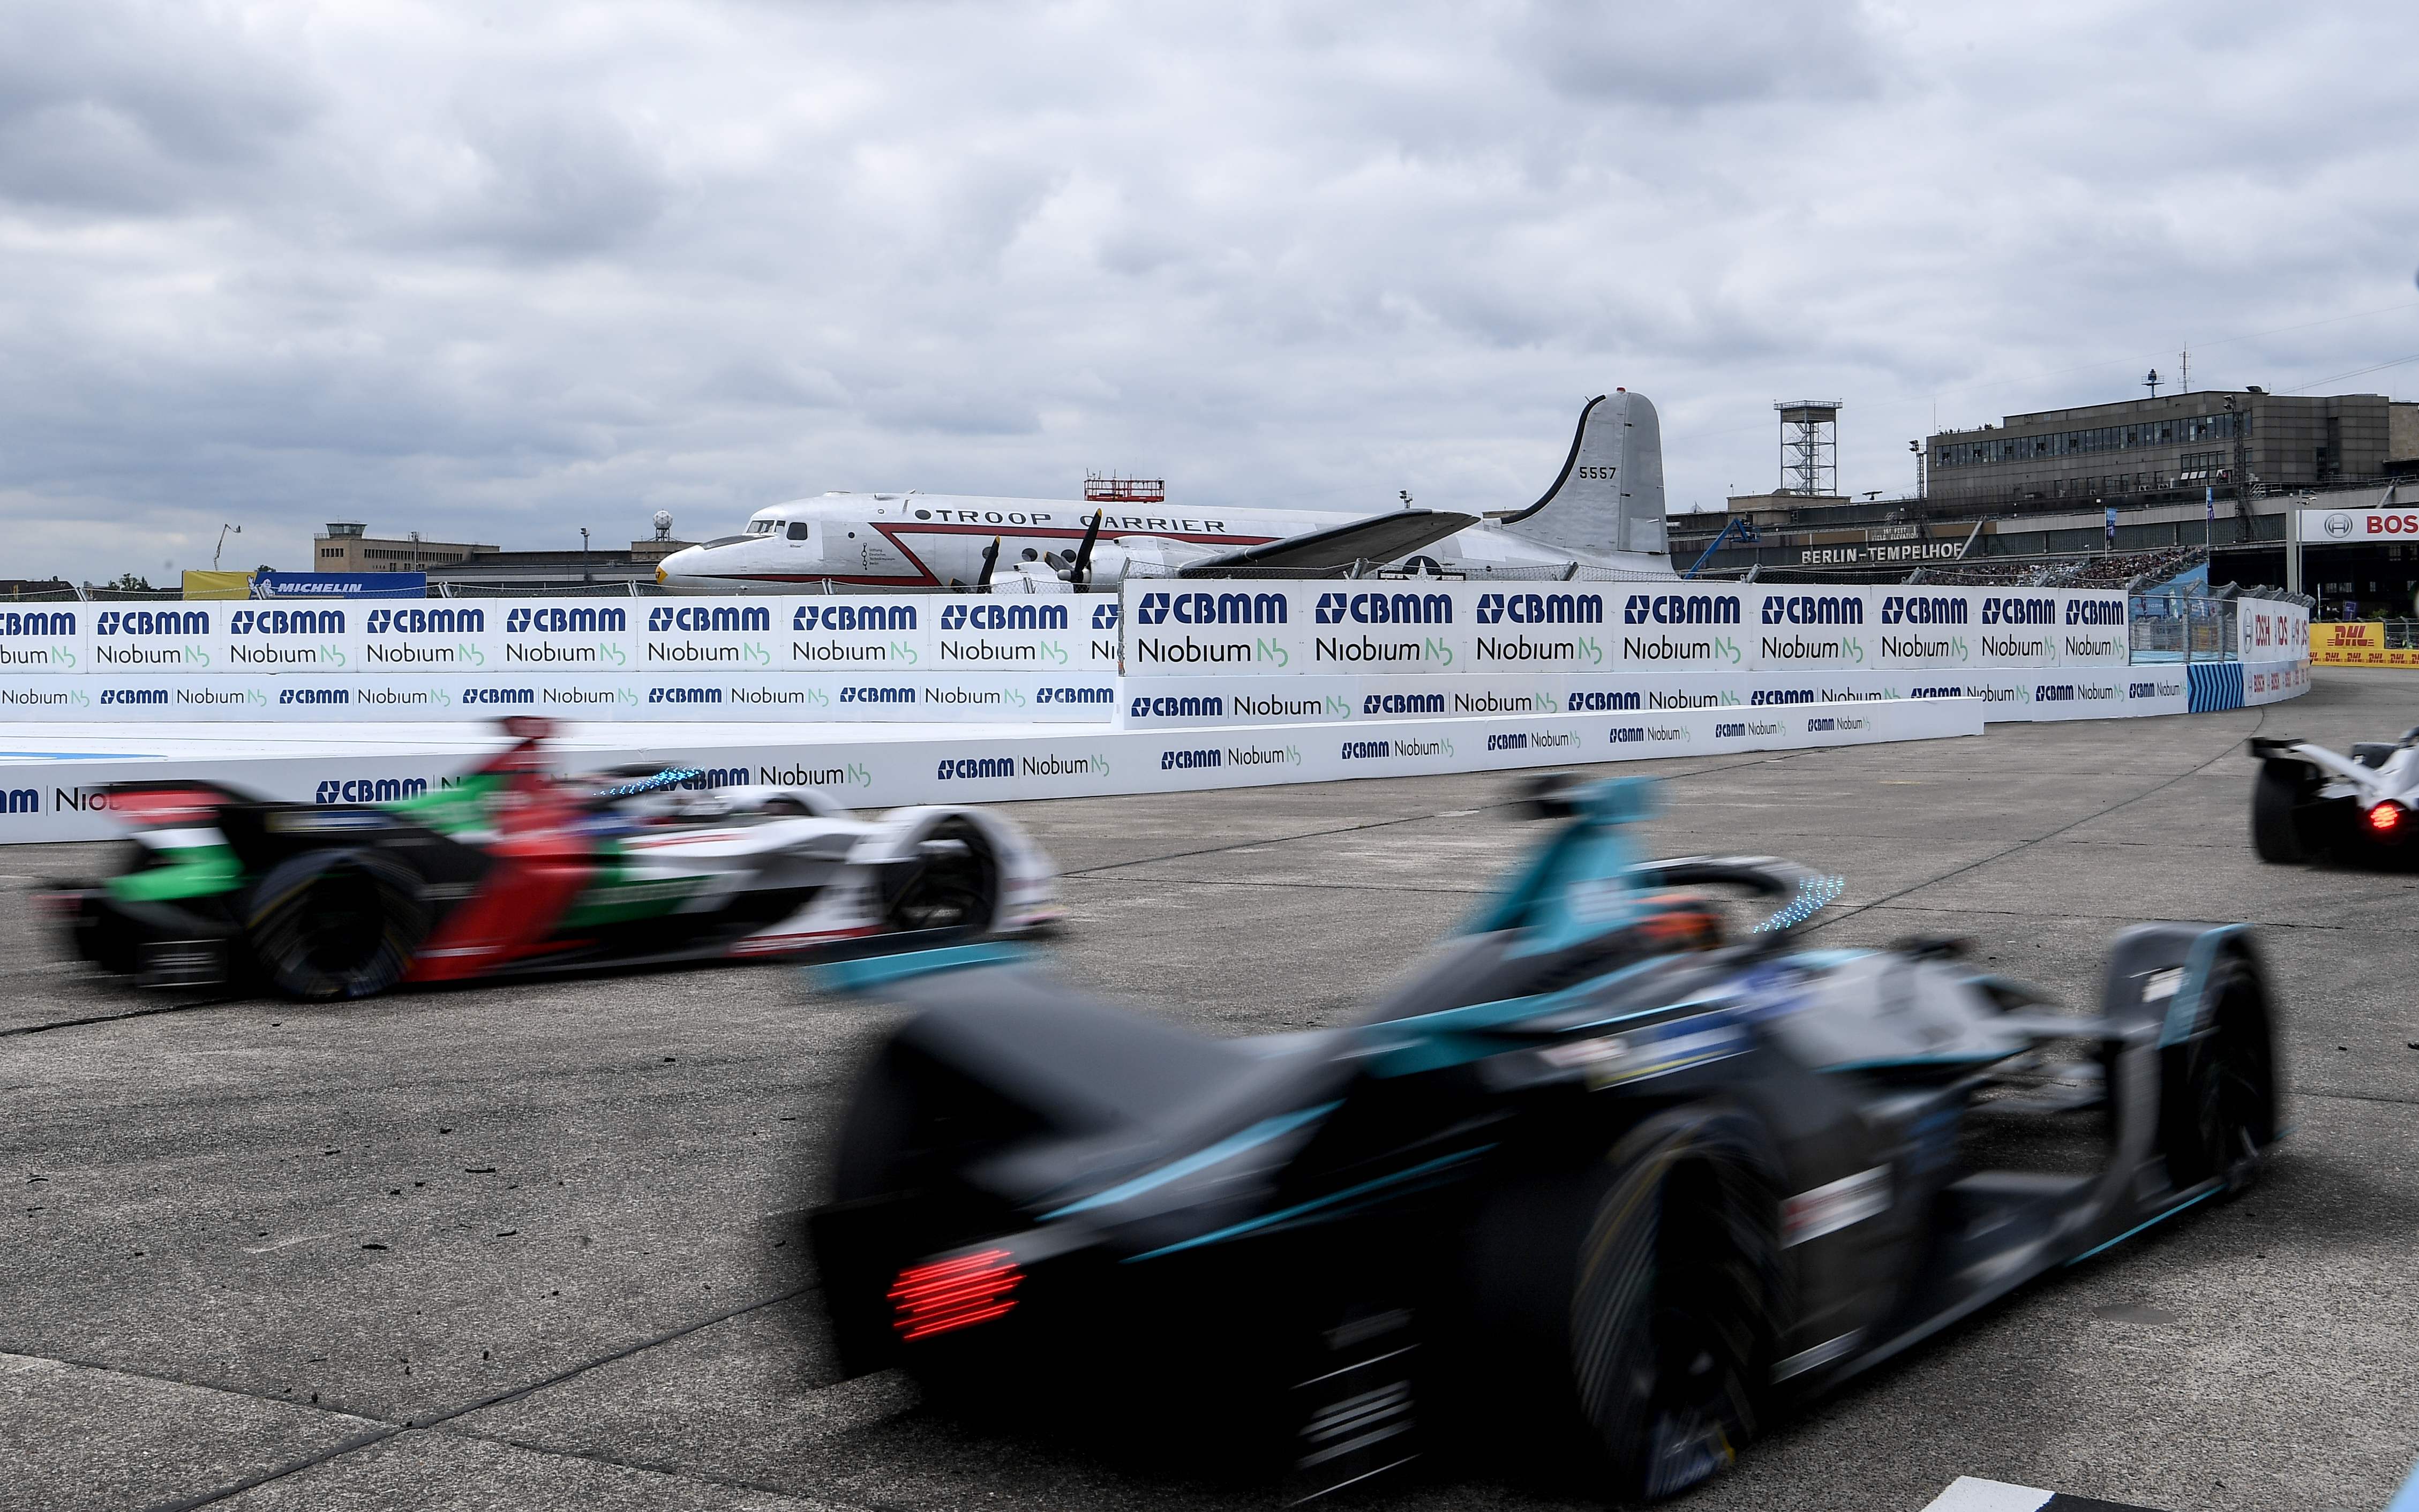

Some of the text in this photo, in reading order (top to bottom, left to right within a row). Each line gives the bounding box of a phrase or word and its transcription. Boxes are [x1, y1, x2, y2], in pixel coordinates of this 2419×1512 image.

[1580, 467, 1616, 479] 5557
[936, 509, 1226, 532] TROOP CARRIER
[1802, 543, 1964, 564] BERLIN-TEMPELHOF
[277, 583, 363, 592] MICHELIN
[677, 607, 769, 630] CBMM
[822, 606, 916, 630] CBMM
[971, 605, 1066, 629] CBMM
[1174, 594, 1287, 623] CBMM
[1350, 594, 1452, 623] CBMM
[1507, 595, 1602, 623] CBMM
[1653, 596, 1740, 624] CBMM
[1787, 597, 1863, 624] CBMM
[1906, 598, 1968, 624] CBMM
[2003, 599, 2055, 624] CBMM
[2082, 600, 2124, 625] CBMM
[123, 611, 208, 634] CBMM
[257, 611, 344, 634] CBMM
[394, 609, 483, 633] CBMM
[534, 608, 625, 631] CBMM
[1762, 635, 1838, 658] Niobium
[1882, 634, 1949, 657] Niobium
[1982, 634, 2042, 656] Niobium
[2066, 634, 2111, 656] Niobium
[2335, 626, 2368, 646] DHL
[98, 644, 180, 663] Niobium
[231, 643, 315, 663] Niobium
[368, 642, 453, 662] Niobium
[507, 641, 595, 661] Niobium
[649, 641, 738, 660] Niobium
[794, 640, 885, 660] Niobium
[942, 639, 1035, 659] Niobium
[1139, 636, 1250, 662] Niobium
[1317, 635, 1420, 661] Niobium
[1477, 635, 1574, 660] Niobium
[1624, 635, 1710, 659] Niobium
[2325, 652, 2340, 662] DHL
[2347, 652, 2362, 662] DHL
[2369, 653, 2383, 663] DHL
[2391, 654, 2405, 664] DHL
[3, 689, 67, 704] Niobium
[117, 690, 168, 703] CBMM
[178, 688, 243, 703] Niobium
[296, 690, 348, 703] CBMM
[359, 688, 426, 703] Niobium
[480, 689, 534, 703] CBMM
[544, 687, 613, 703] Niobium
[666, 688, 721, 703] CBMM
[732, 687, 803, 703] Niobium
[858, 688, 915, 702] CBMM
[926, 687, 1000, 703] Niobium
[1055, 688, 1113, 703] CBMM
[1766, 690, 1813, 705] CBMM
[1967, 684, 2014, 702] Niobium
[2046, 684, 2074, 701] CBMM
[2078, 682, 2113, 699] Niobium
[2136, 682, 2154, 697] CBMM
[2157, 680, 2180, 696] Niobium
[1153, 697, 1221, 716] CBMM
[1235, 694, 1321, 716] Niobium
[1384, 695, 1444, 712] CBMM
[1456, 691, 1531, 713] Niobium
[1586, 693, 1640, 710] CBMM
[1650, 689, 1717, 709] Niobium
[1618, 727, 1644, 742] CBMM
[1648, 725, 1680, 741] Niobium
[1723, 723, 1745, 737] CBMM
[1748, 720, 1775, 735] Niobium
[1814, 718, 1834, 731] CBMM
[1837, 716, 1861, 730] Niobium
[1353, 741, 1389, 758] CBMM
[1395, 738, 1439, 756] Niobium
[1497, 733, 1527, 750] CBMM
[1531, 732, 1568, 748] Niobium
[956, 758, 1014, 778] CBMM
[1023, 754, 1087, 776] Niobium
[1175, 749, 1221, 768] CBMM
[1229, 746, 1283, 765] Niobium
[761, 763, 844, 785] Niobium
